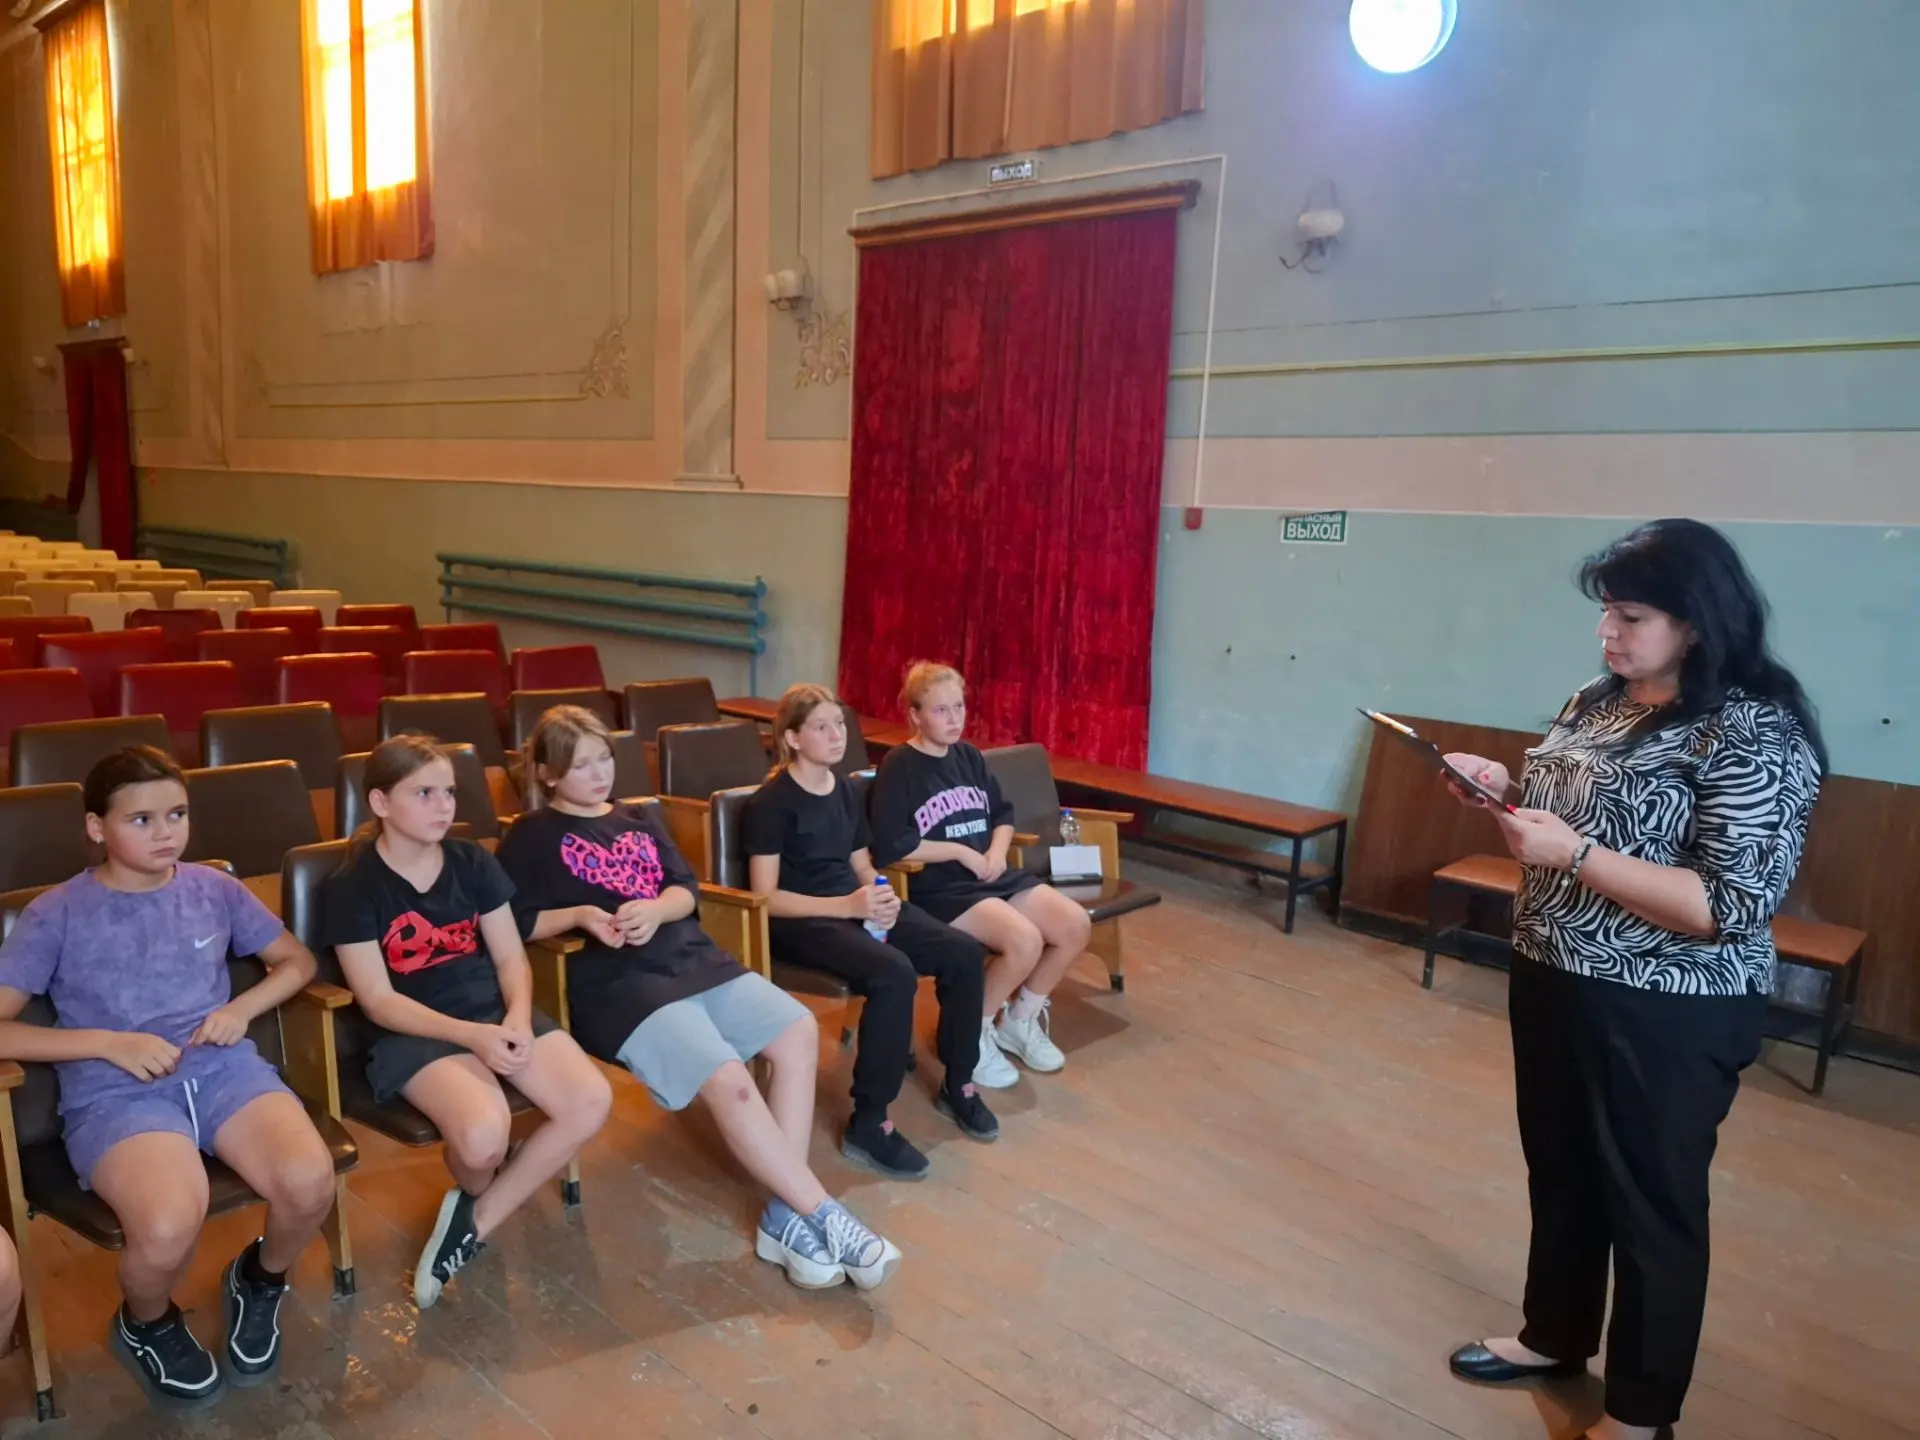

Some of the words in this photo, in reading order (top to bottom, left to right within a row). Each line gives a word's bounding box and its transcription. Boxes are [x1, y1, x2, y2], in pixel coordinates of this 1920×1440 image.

[1288, 512, 1342, 523] ПАСНЫЙ
[1287, 522, 1341, 541] ВЫХОД
[914, 786, 990, 837] BROOKL
[945, 822, 969, 839] NEW
